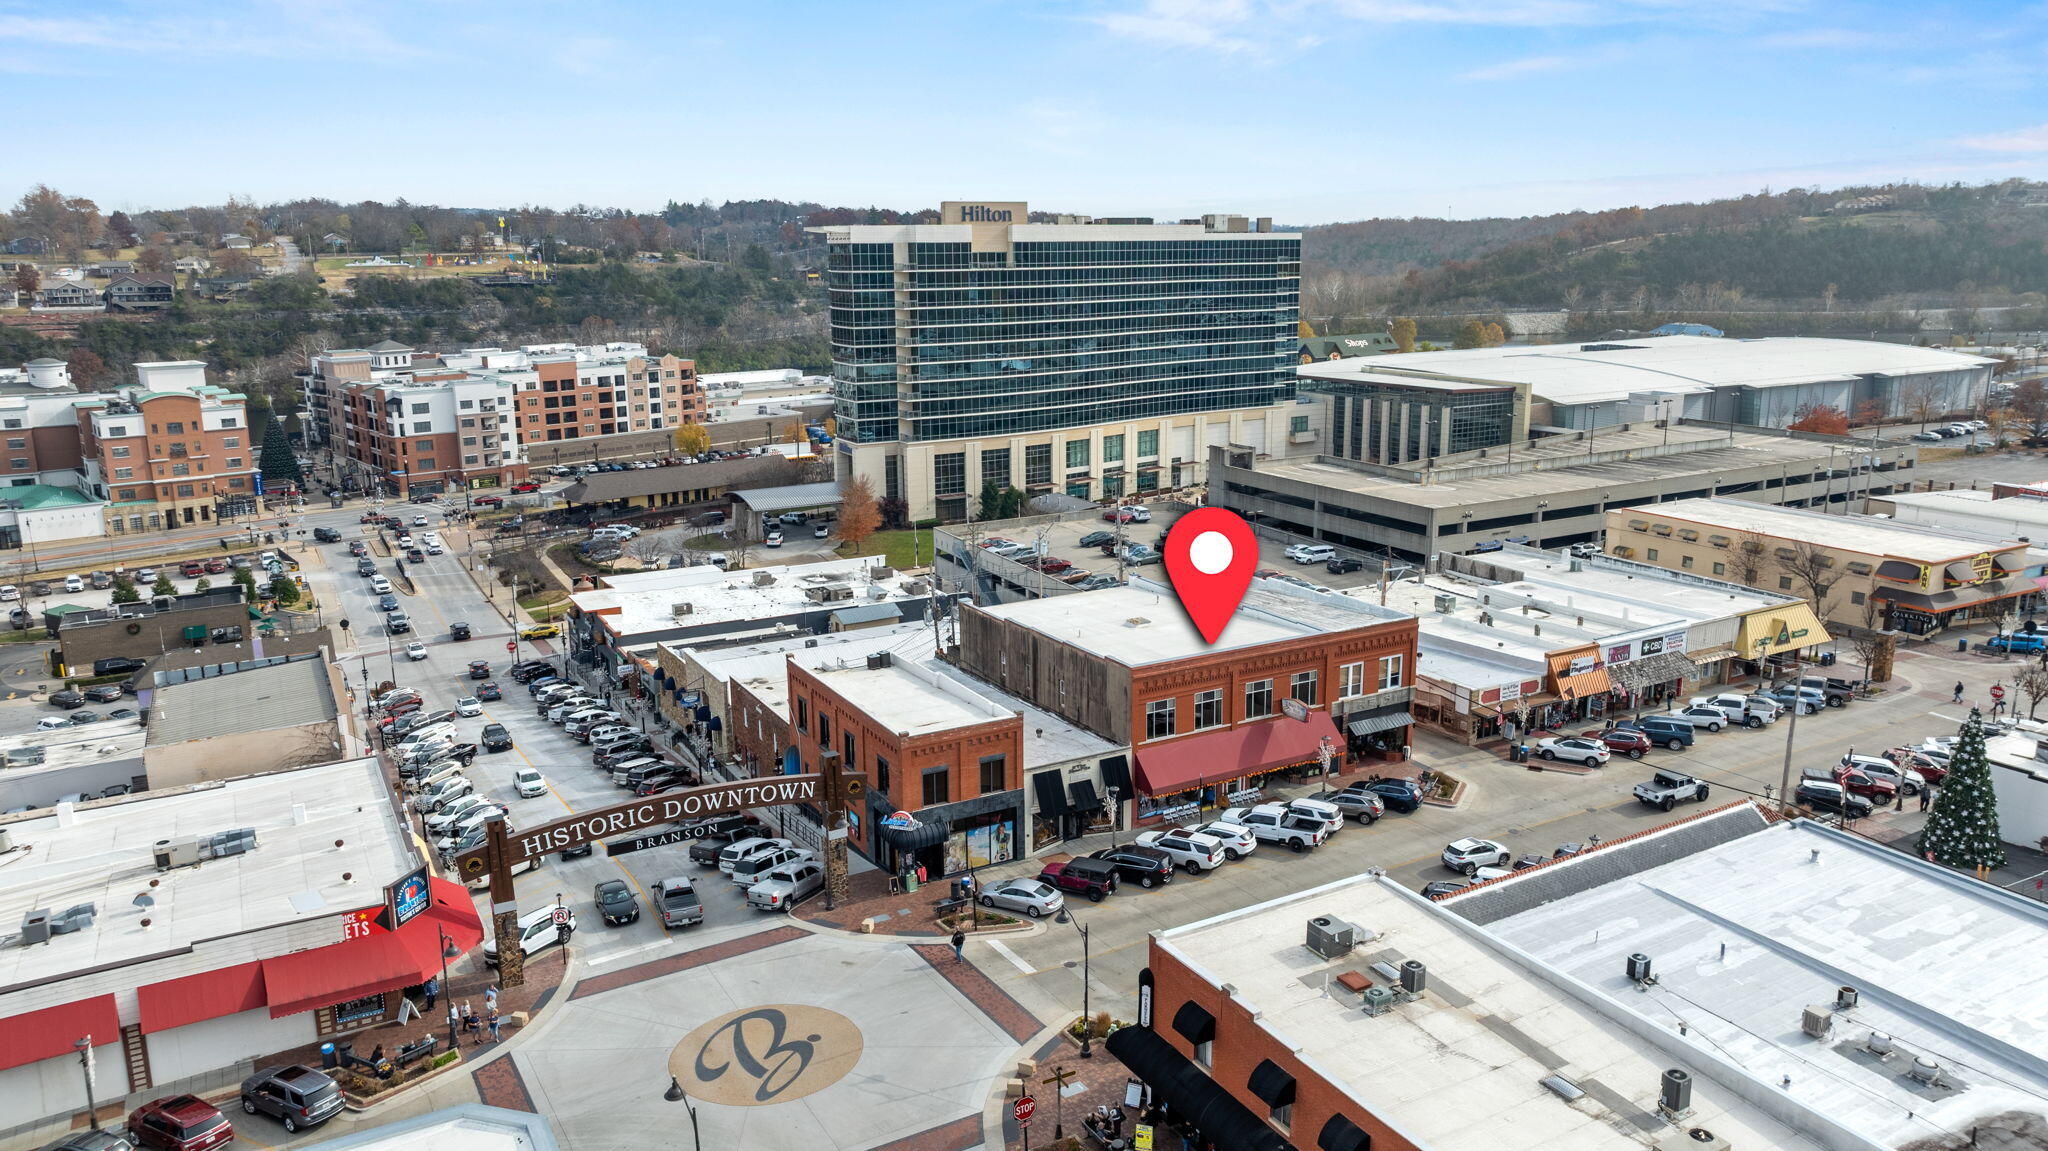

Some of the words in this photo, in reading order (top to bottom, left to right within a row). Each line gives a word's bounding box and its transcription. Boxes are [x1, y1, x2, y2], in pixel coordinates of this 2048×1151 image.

[960, 205, 1012, 222] Hilton
[1344, 339, 1368, 348] Shops
[1896, 612, 1929, 622] PARKING
[1650, 640, 1663, 651] CBD
[521, 805, 655, 857] HISTORIC
[663, 781, 816, 820] DOWNTOWN
[636, 823, 718, 850] BRANSON
[1015, 1102, 1035, 1116] STOP
